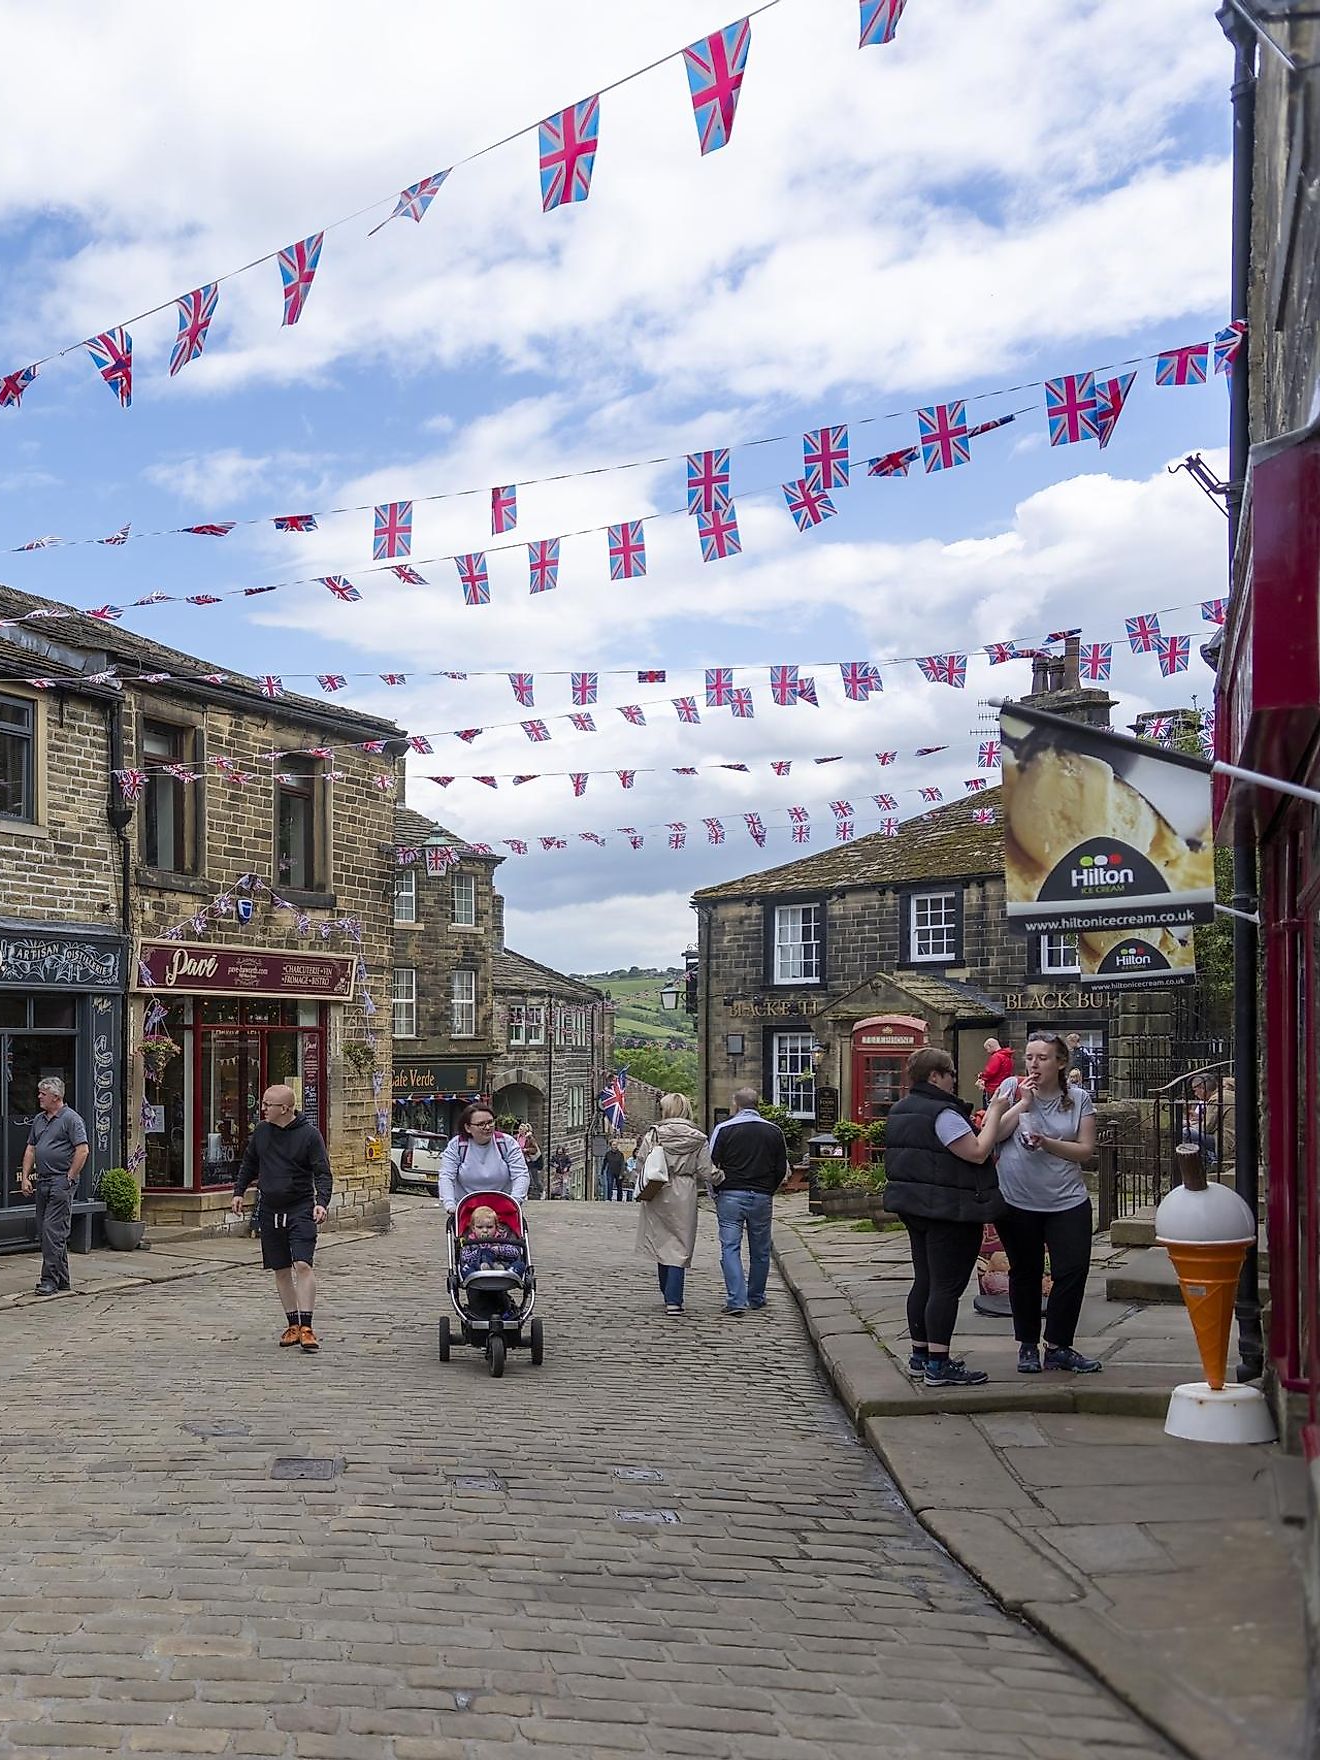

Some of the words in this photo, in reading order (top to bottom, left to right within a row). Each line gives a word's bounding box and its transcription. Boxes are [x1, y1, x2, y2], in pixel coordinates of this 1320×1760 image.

[1071, 867, 1134, 887] Hilton
[1081, 887, 1094, 895] ICE
[1025, 909, 1195, 932] www.hiltonicecream.co.uk
[16, 944, 60, 960] ARTISAN
[66, 948, 107, 975] DISTILLERIE
[1116, 954, 1151, 966] Hilton
[1091, 977, 1186, 991] www.hiltonicecream.co.uk
[1006, 992, 1072, 1010] BLACK
[409, 1069, 435, 1087] Verde
